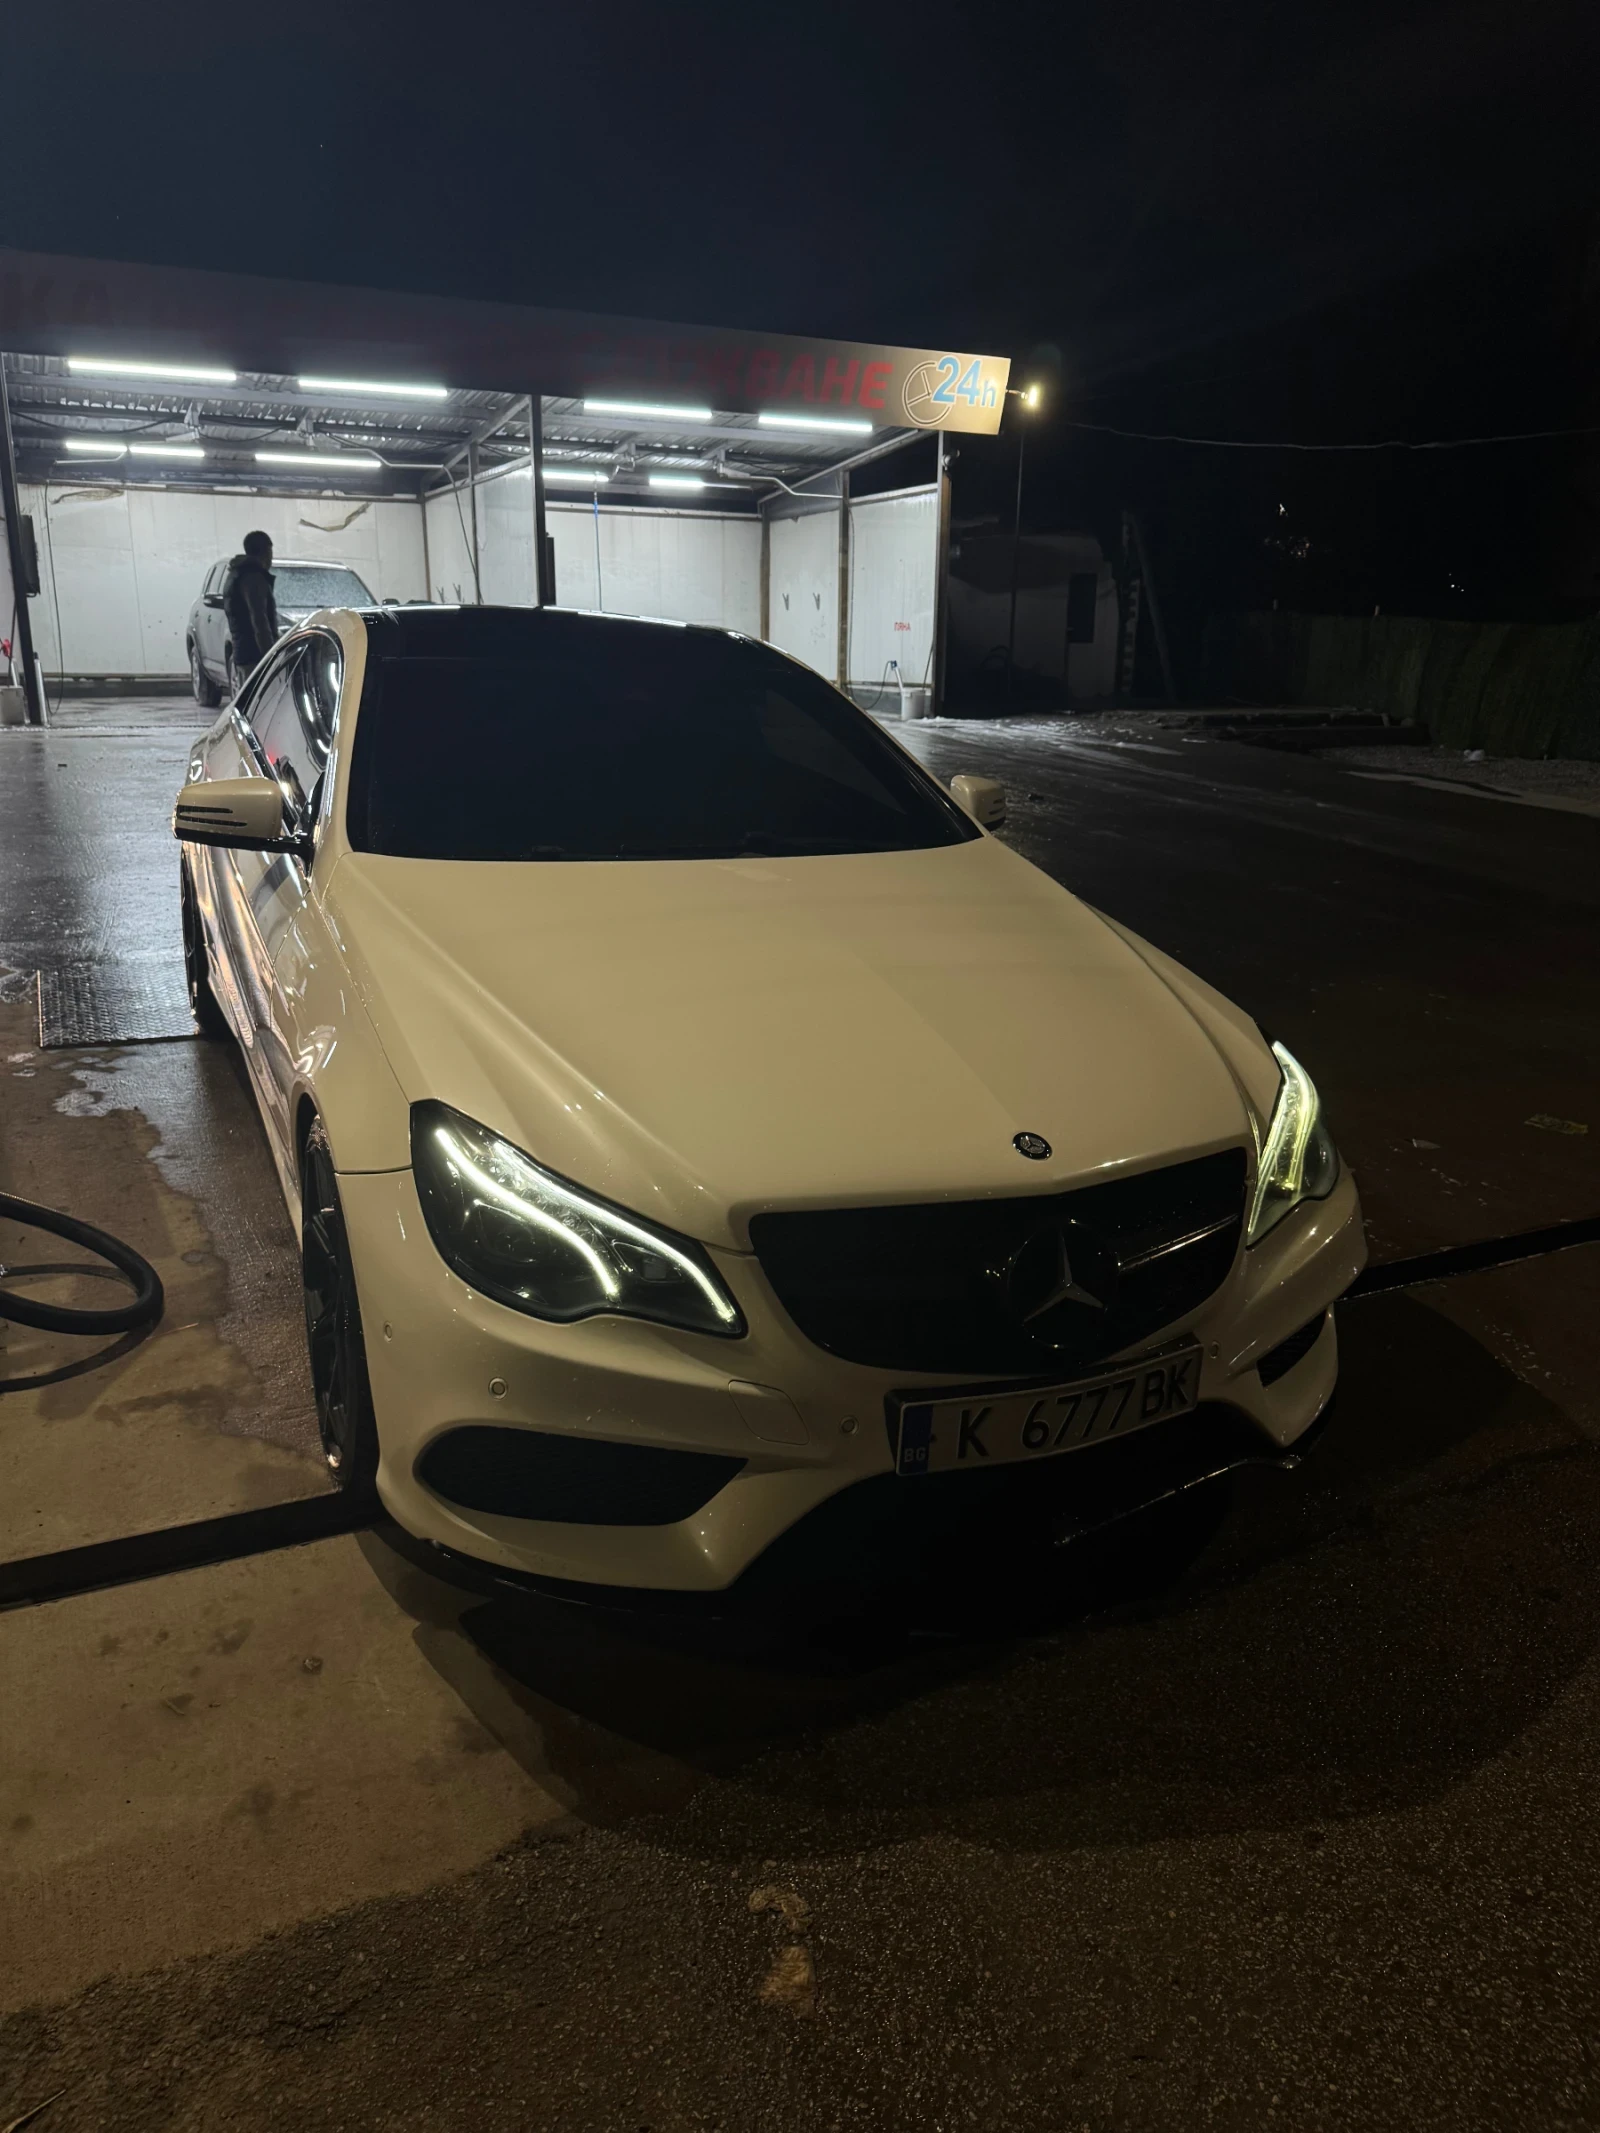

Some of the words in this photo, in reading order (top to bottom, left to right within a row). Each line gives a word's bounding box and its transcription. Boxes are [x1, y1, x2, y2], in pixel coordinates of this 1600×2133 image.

[933, 356, 997, 408] 24h
[903, 1448, 929, 1463] BG
[957, 1406, 992, 1459] K
[1021, 1377, 1138, 1450] 6777
[1140, 1358, 1193, 1420] BK
